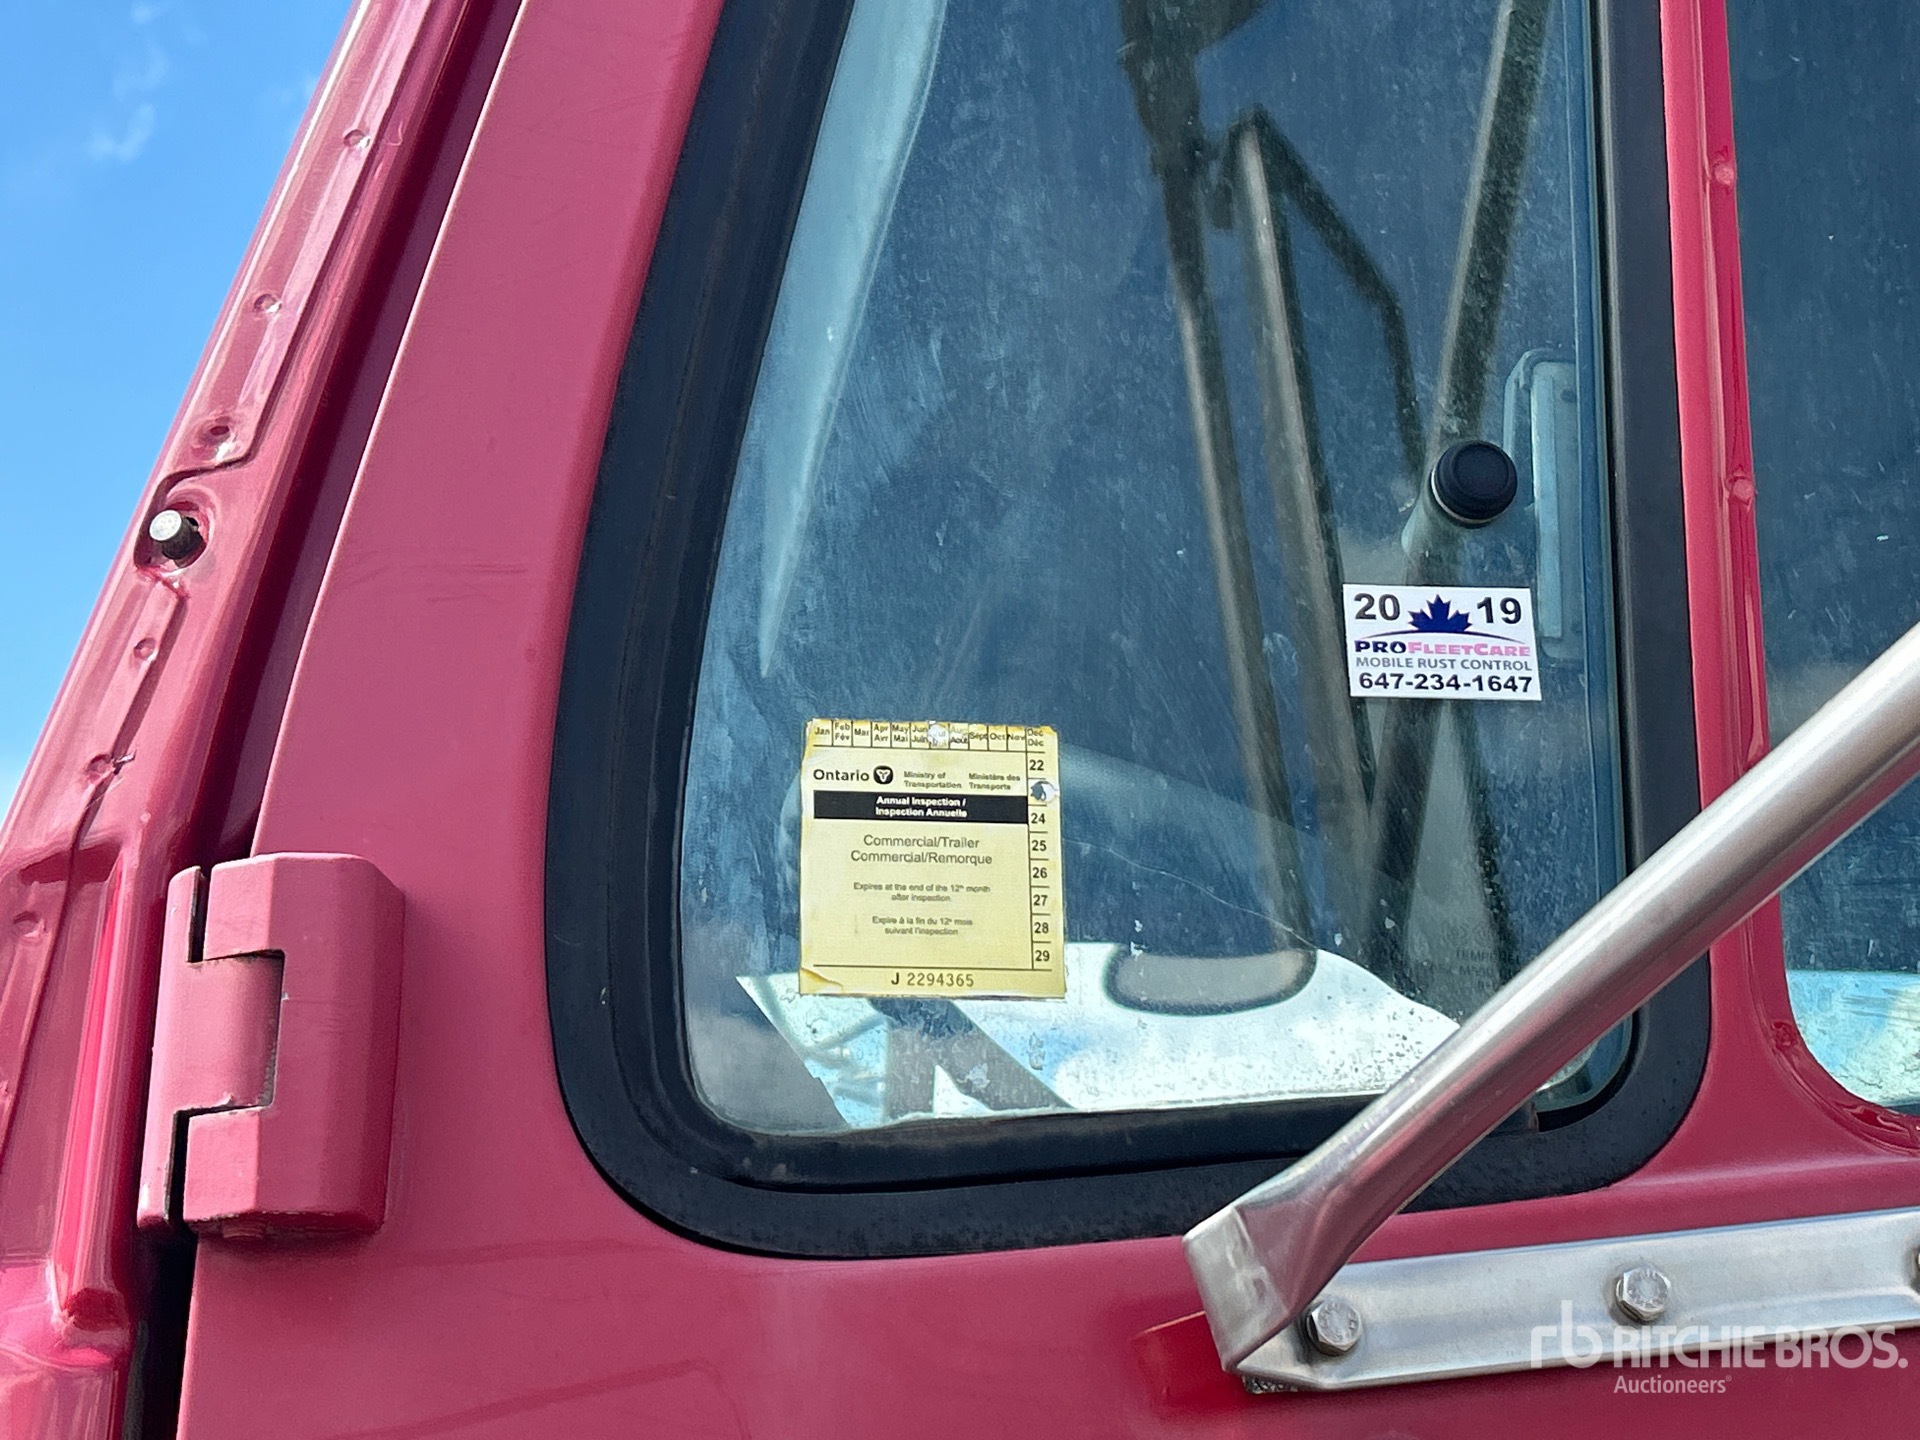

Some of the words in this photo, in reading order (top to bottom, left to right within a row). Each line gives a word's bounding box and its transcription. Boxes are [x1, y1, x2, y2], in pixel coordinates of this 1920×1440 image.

[1353, 592, 1401, 622] 20
[1476, 596, 1522, 625] 19
[1355, 656, 1414, 669] MOBILE
[1417, 658, 1457, 670] RUST
[1460, 659, 1533, 672] CONTROL
[1358, 672, 1533, 693] 647-234-1647
[814, 726, 831, 736] Jan
[834, 721, 851, 731] Feb
[873, 723, 889, 733] Apr
[892, 724, 909, 734] May
[989, 732, 1006, 741] Oct
[1029, 759, 1045, 771] 22
[812, 768, 870, 782] Ontario
[903, 771, 936, 780] Ministry
[937, 771, 946, 779] of
[1006, 773, 1021, 782] des
[903, 780, 962, 789] Transportation
[968, 782, 1011, 791] Transports
[876, 795, 910, 806] Annual
[911, 796, 961, 807] Inspection
[875, 806, 925, 818] Inspection
[925, 807, 968, 818] Annuelle
[1030, 813, 1046, 824] 24
[863, 834, 980, 849] Commercial/Trailer
[1031, 840, 1047, 851] 25
[850, 849, 993, 866] Commercial/Remorque
[1032, 867, 1048, 879] 26
[853, 881, 883, 892] Expires
[885, 883, 893, 891] at
[894, 883, 907, 891] the
[908, 883, 924, 892] end
[925, 883, 934, 892] of
[935, 884, 948, 892] the
[1032, 894, 1048, 906] 27
[872, 915, 898, 925] Expire
[906, 916, 914, 925] la
[915, 916, 926, 925] fin
[927, 917, 938, 926] du
[954, 918, 973, 926] mois
[884, 926, 913, 935] suivant
[1033, 922, 1049, 934] 28
[1034, 949, 1051, 962] 29
[890, 972, 900, 986] J
[906, 972, 975, 988] 2294365
